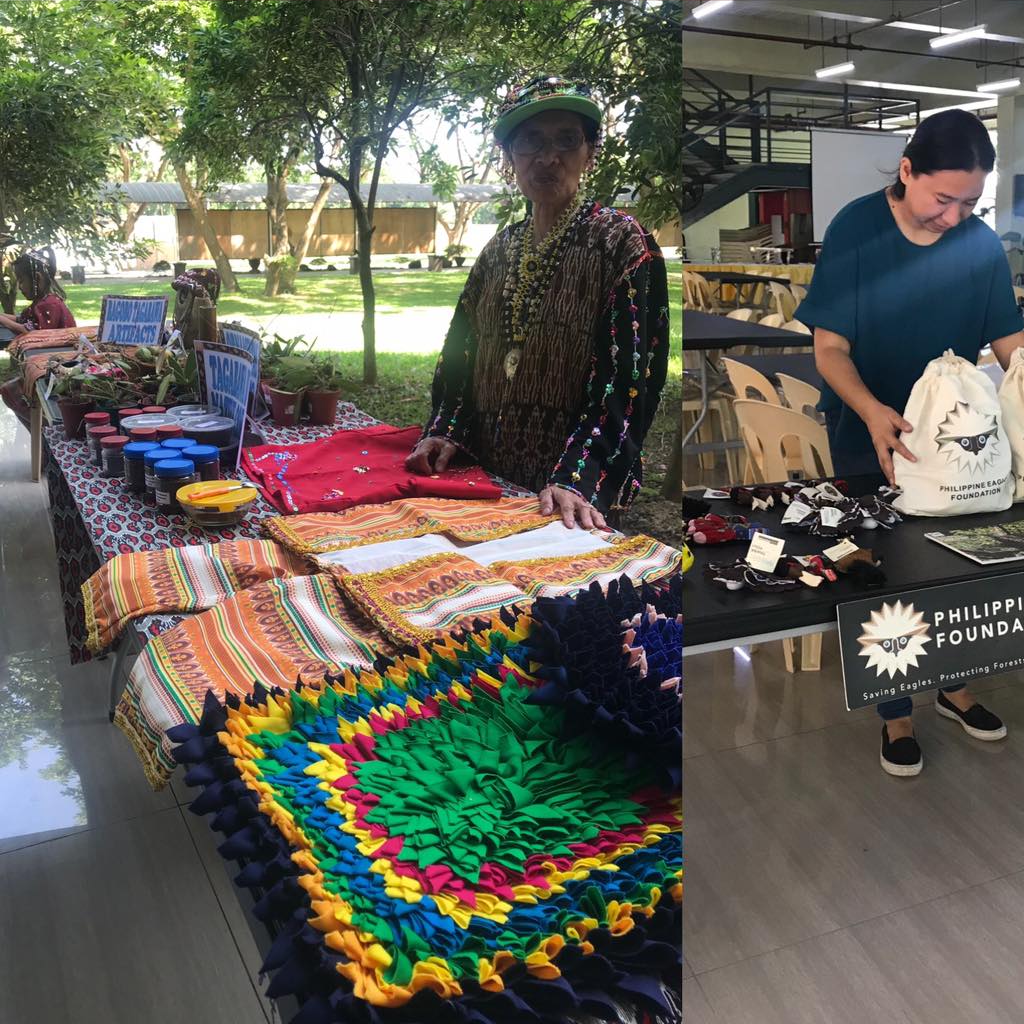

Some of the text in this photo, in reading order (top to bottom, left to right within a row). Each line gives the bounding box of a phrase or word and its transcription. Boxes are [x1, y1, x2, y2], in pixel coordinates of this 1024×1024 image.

[107, 324, 157, 343] ARTIFACTS
[939, 482, 986, 492] PHILIPPINE
[951, 489, 1001, 501] FOUNDATION
[863, 686, 895, 701] Saving
[900, 679, 935, 691] Eagles.
[940, 665, 990, 681] Protecting
